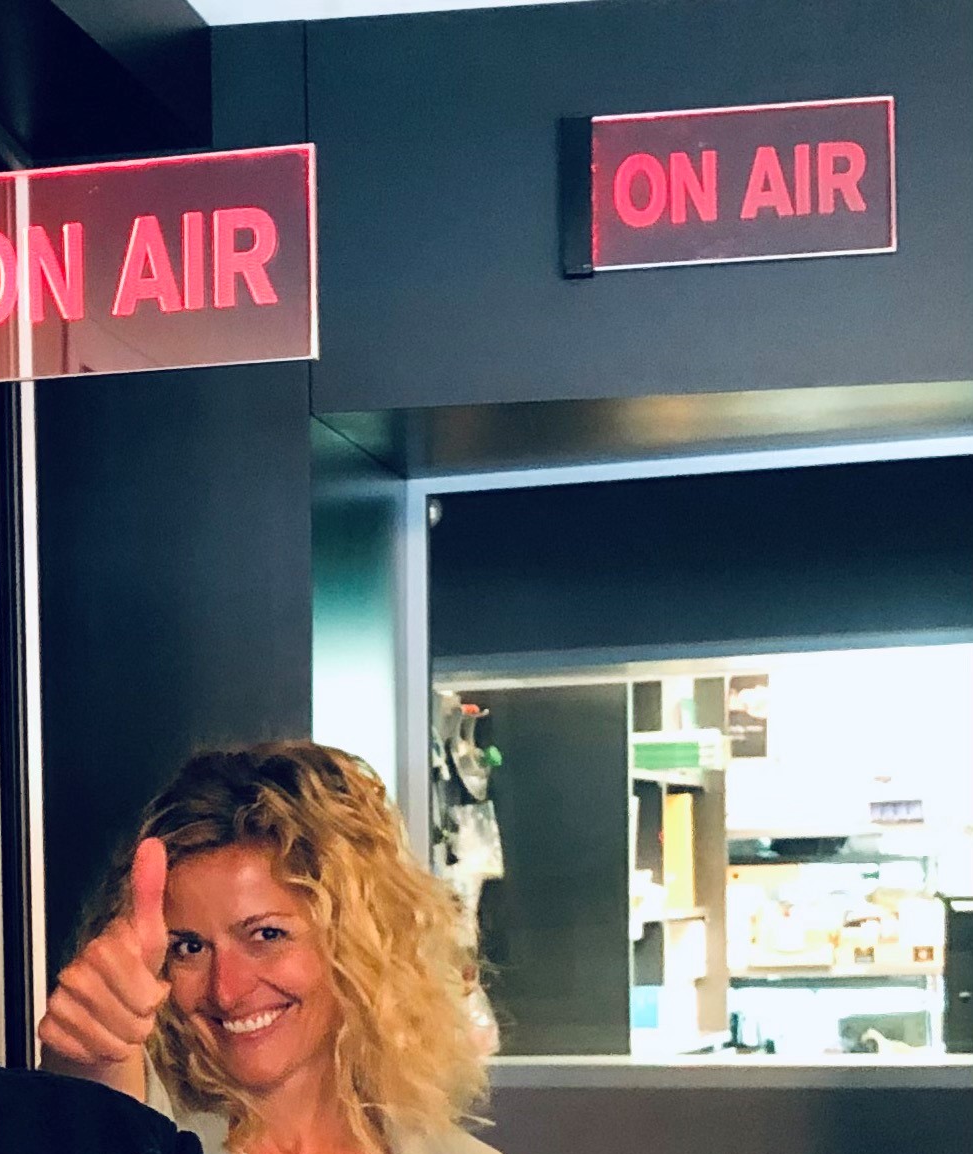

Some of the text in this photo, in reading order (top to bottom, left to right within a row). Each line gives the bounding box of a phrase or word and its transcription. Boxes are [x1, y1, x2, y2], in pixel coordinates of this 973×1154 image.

[613, 141, 867, 228] ON AIR
[111, 207, 279, 316] AIR
